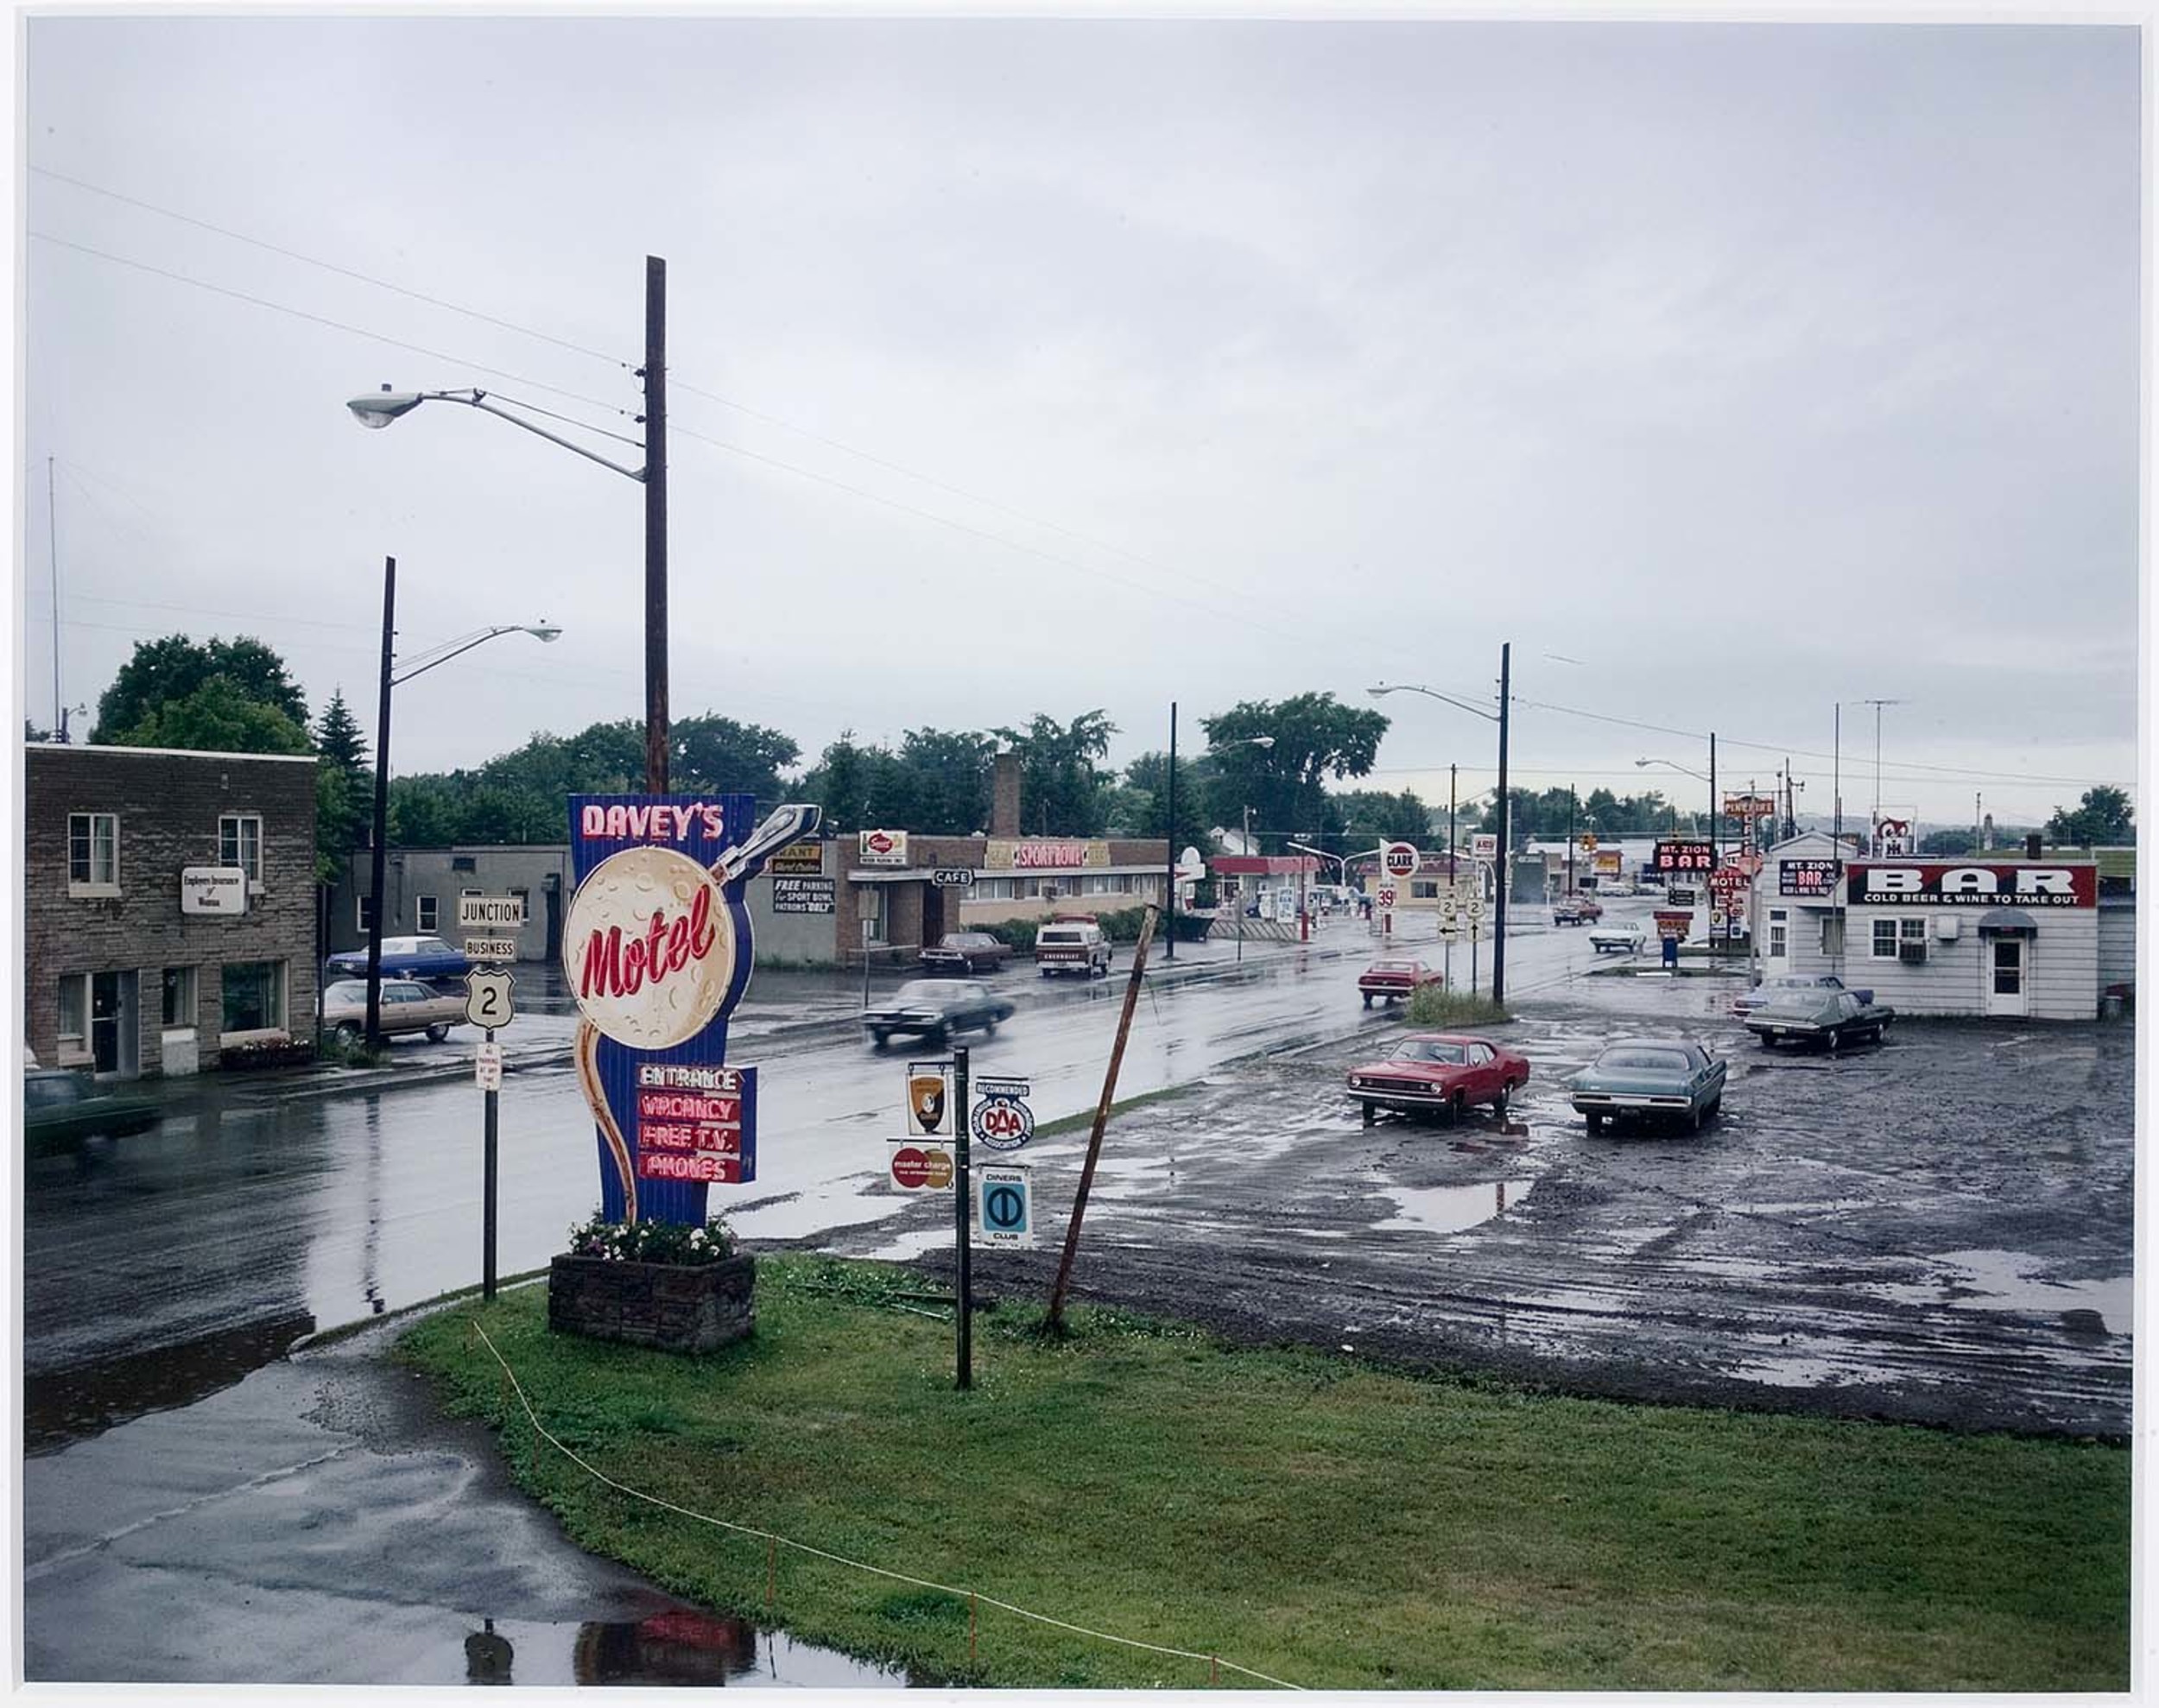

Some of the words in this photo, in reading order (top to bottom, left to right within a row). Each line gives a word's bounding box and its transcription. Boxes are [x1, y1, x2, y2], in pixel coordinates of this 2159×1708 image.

[582, 801, 724, 840] DAVEY'S
[1387, 855, 1414, 867] CLARK
[1660, 855, 1712, 868] BAR
[935, 872, 968, 882] CAFE
[1710, 876, 1751, 887] MOTEL
[1797, 870, 1822, 886] BAR
[1867, 868, 2075, 893] BAR
[775, 880, 801, 890] FREE
[802, 881, 833, 890] PARKING
[787, 892, 811, 901] SPORT
[813, 892, 833, 901] BOWL
[1864, 893, 1897, 902] COLD
[1903, 894, 1938, 903] BEER
[1943, 895, 1953, 903] &
[1955, 895, 1989, 903] WINE
[1994, 895, 2011, 904] TO
[2016, 895, 2048, 904] TAKE
[2053, 895, 2080, 904] OUT
[462, 903, 520, 921] JUNCTION
[1443, 901, 1452, 913] 2
[1471, 901, 1479, 913] 2
[467, 941, 513, 955] BUSINESS
[580, 883, 716, 1000] Motel
[482, 986, 497, 1015] 2
[640, 1066, 737, 1090] ENTRANCE
[642, 1095, 734, 1119] VACANCY
[643, 1125, 691, 1148] FREE
[647, 1156, 726, 1180] PHONES
